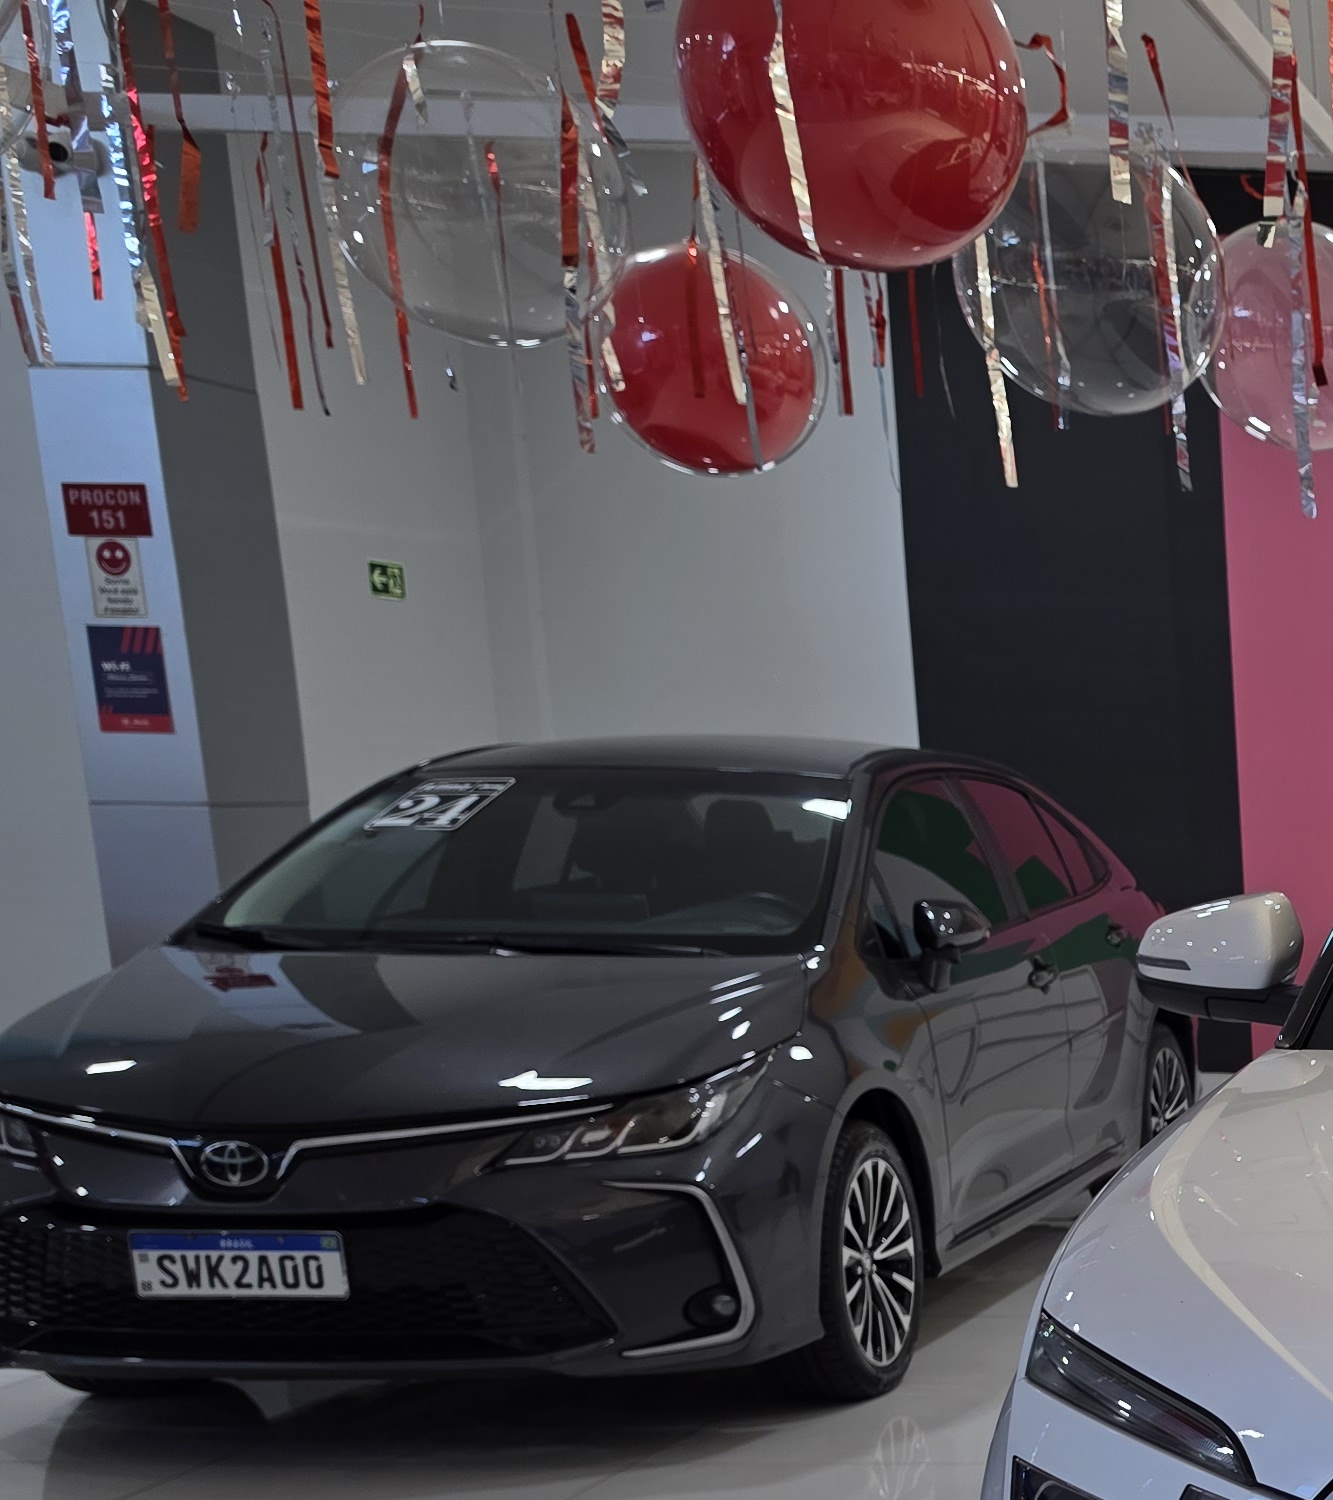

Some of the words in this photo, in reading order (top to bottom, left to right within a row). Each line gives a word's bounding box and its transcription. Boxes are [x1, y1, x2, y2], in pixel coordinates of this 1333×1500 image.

[68, 487, 141, 507] PROCON
[89, 508, 127, 530] 151
[371, 794, 481, 826] 24
[156, 1254, 324, 1289] SWK2A00
